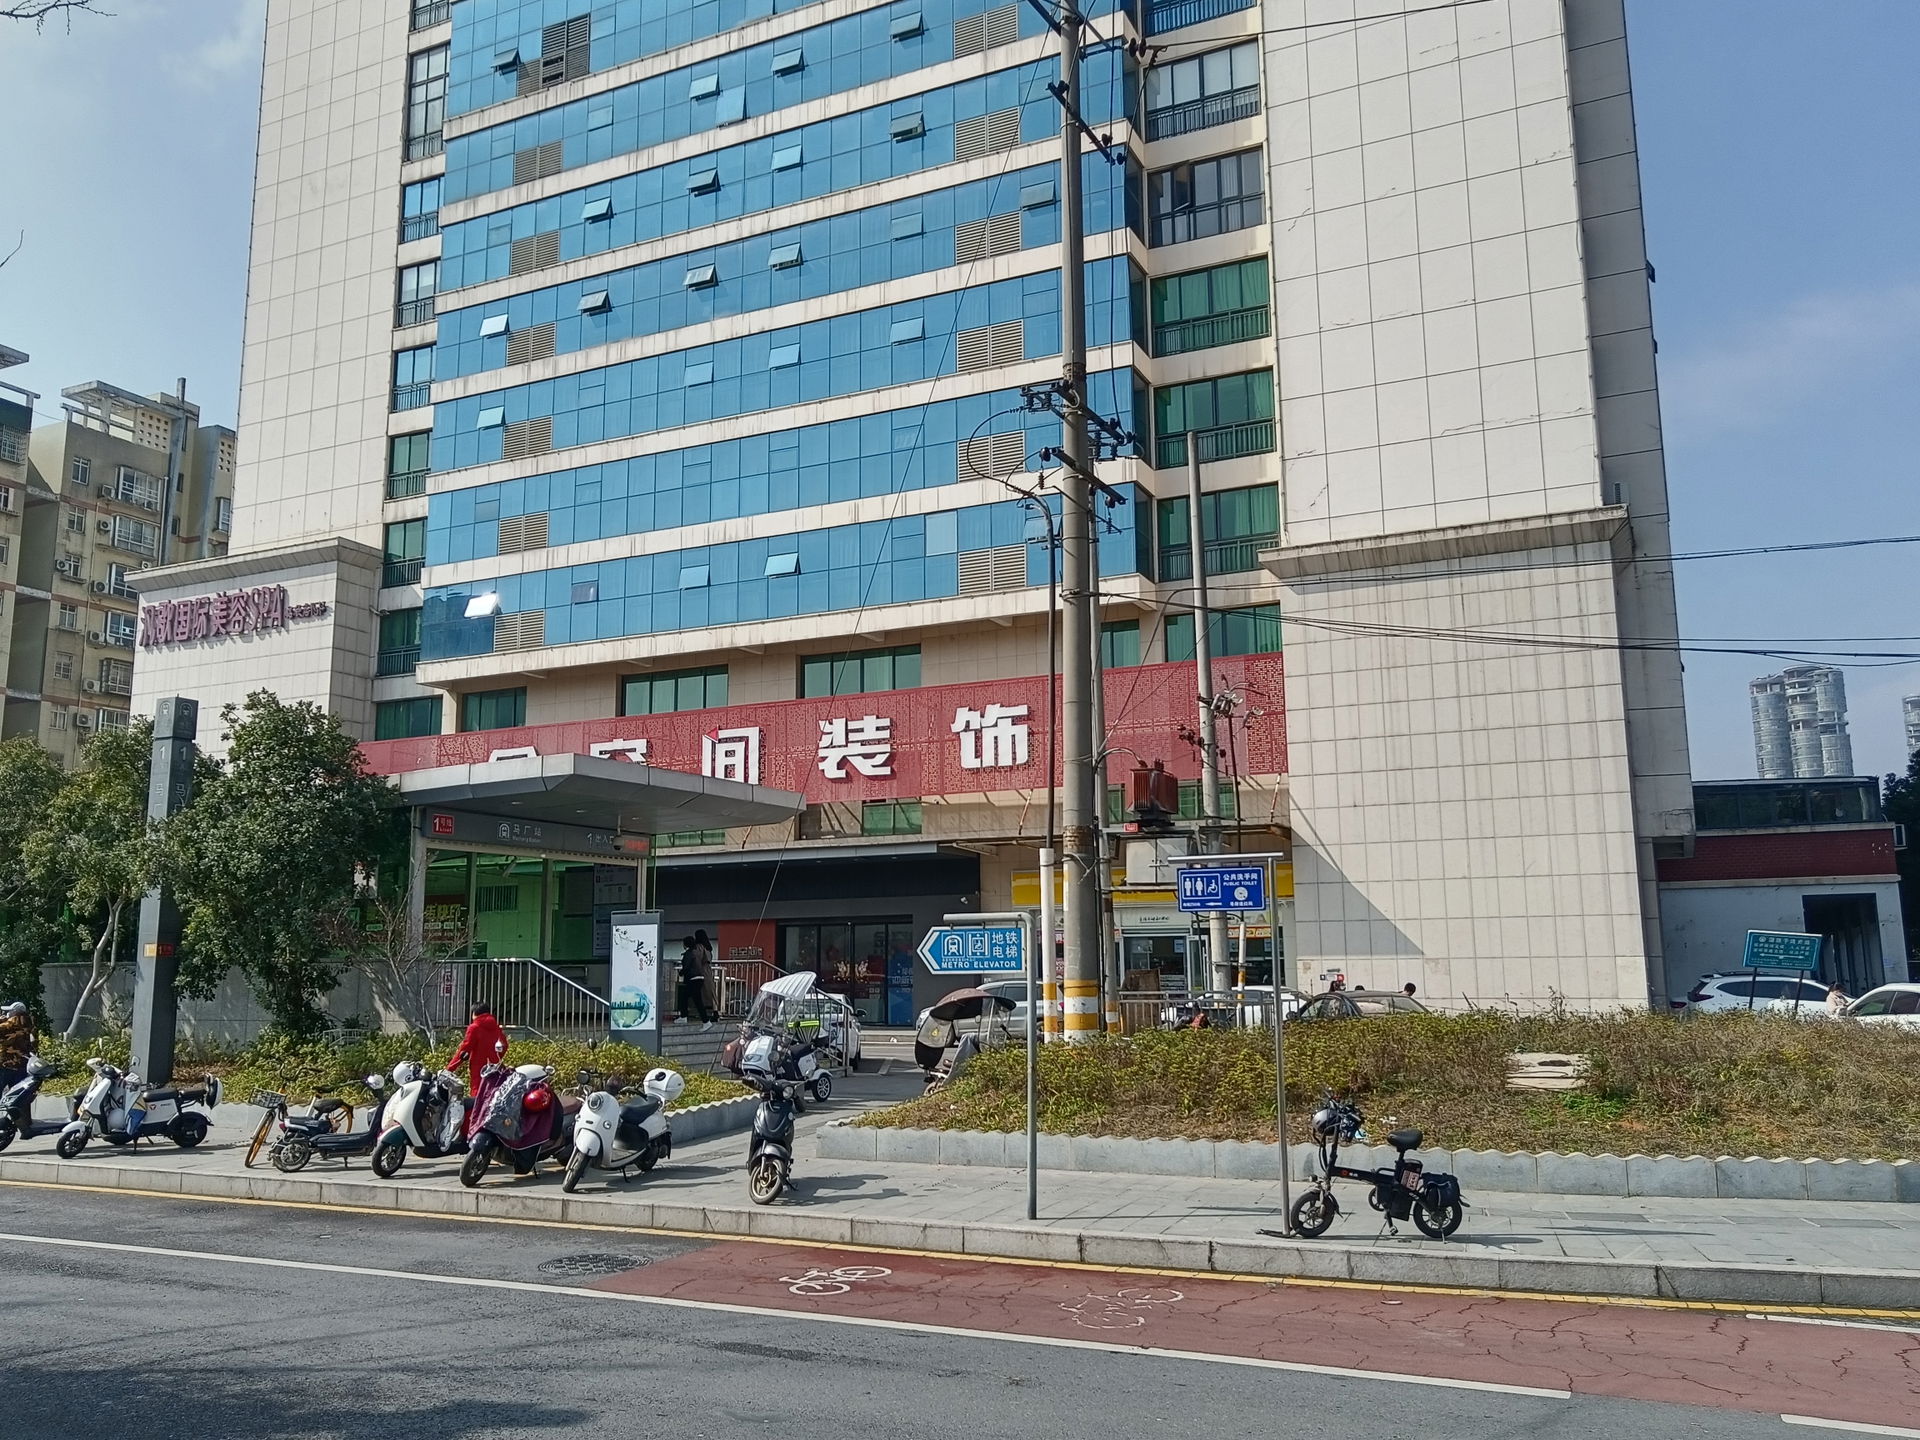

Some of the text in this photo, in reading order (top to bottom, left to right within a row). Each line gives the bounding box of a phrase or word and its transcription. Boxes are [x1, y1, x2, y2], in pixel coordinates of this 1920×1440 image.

[1223, 873, 1258, 881] 公共洗手间
[992, 931, 1019, 944] 地铁
[993, 945, 1018, 958] 电梯
[973, 960, 1017, 968] ELEVATOR
